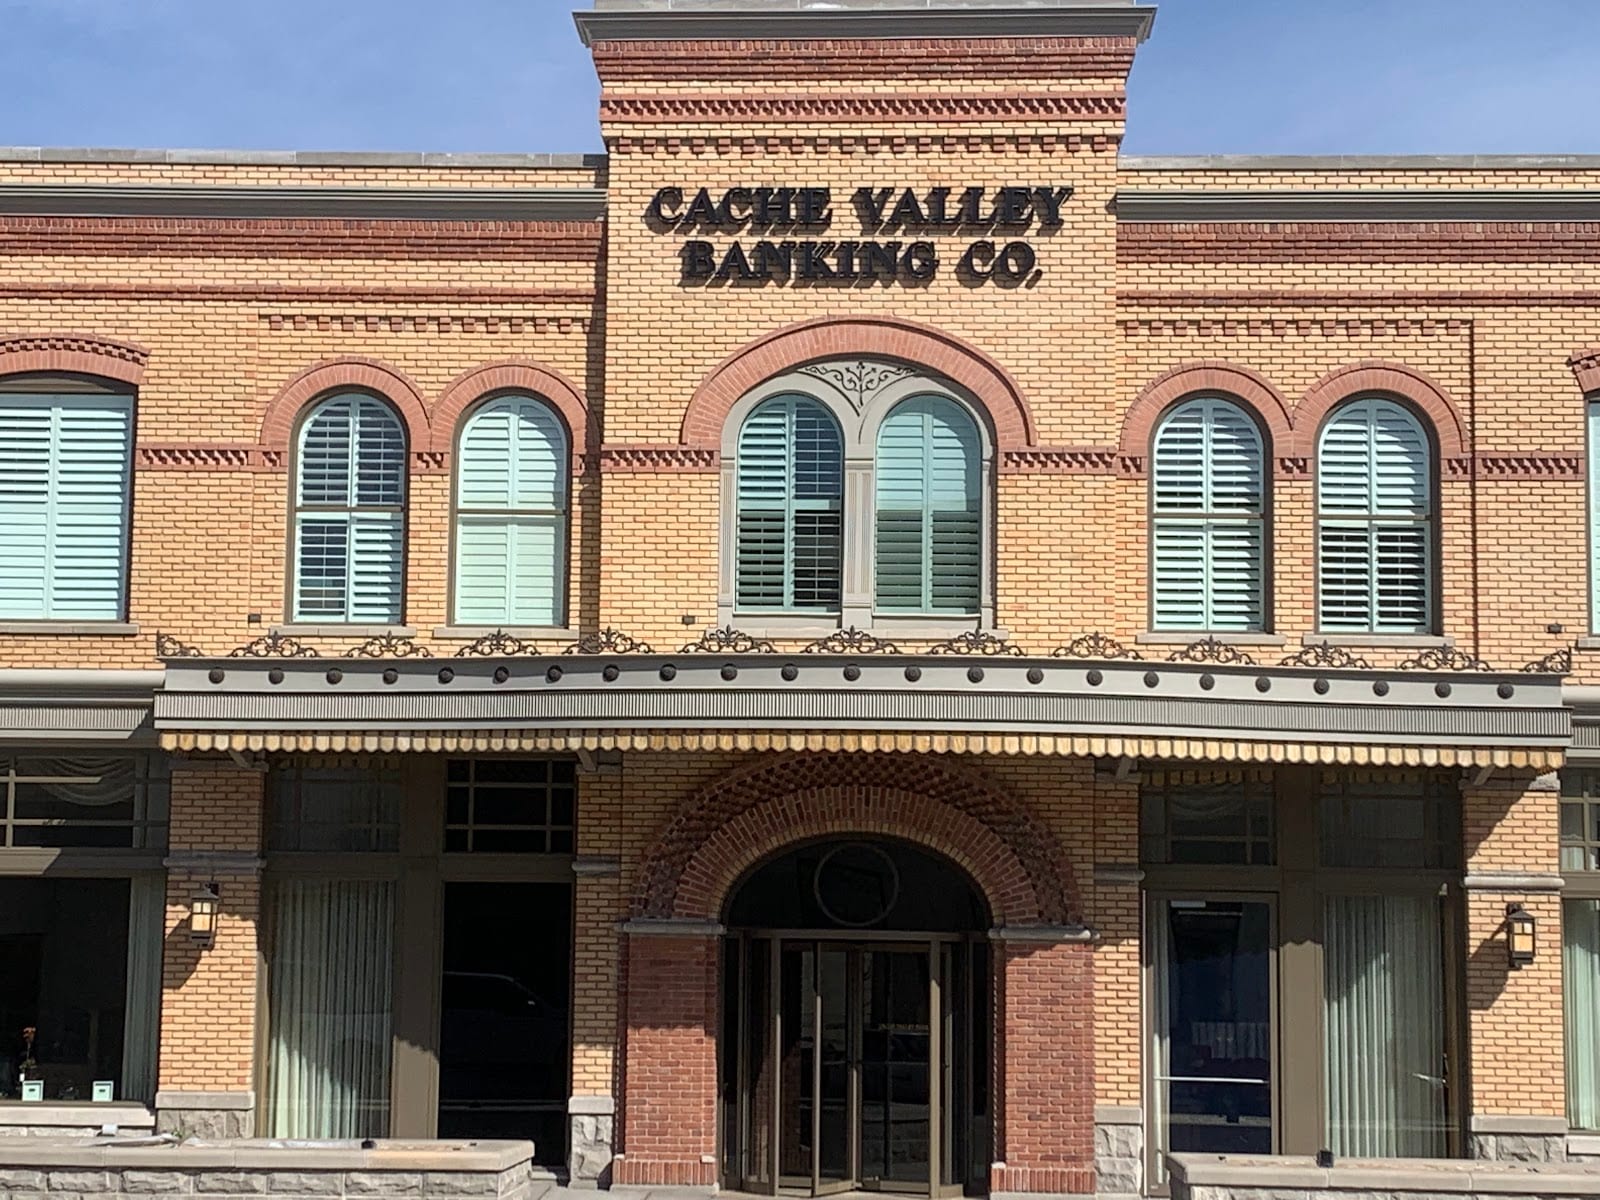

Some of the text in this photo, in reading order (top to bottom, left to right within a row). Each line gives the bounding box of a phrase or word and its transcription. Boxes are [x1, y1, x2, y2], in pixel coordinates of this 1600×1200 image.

[649, 186, 1074, 226] CACHE VALLEY
[683, 240, 940, 280] BANKING
